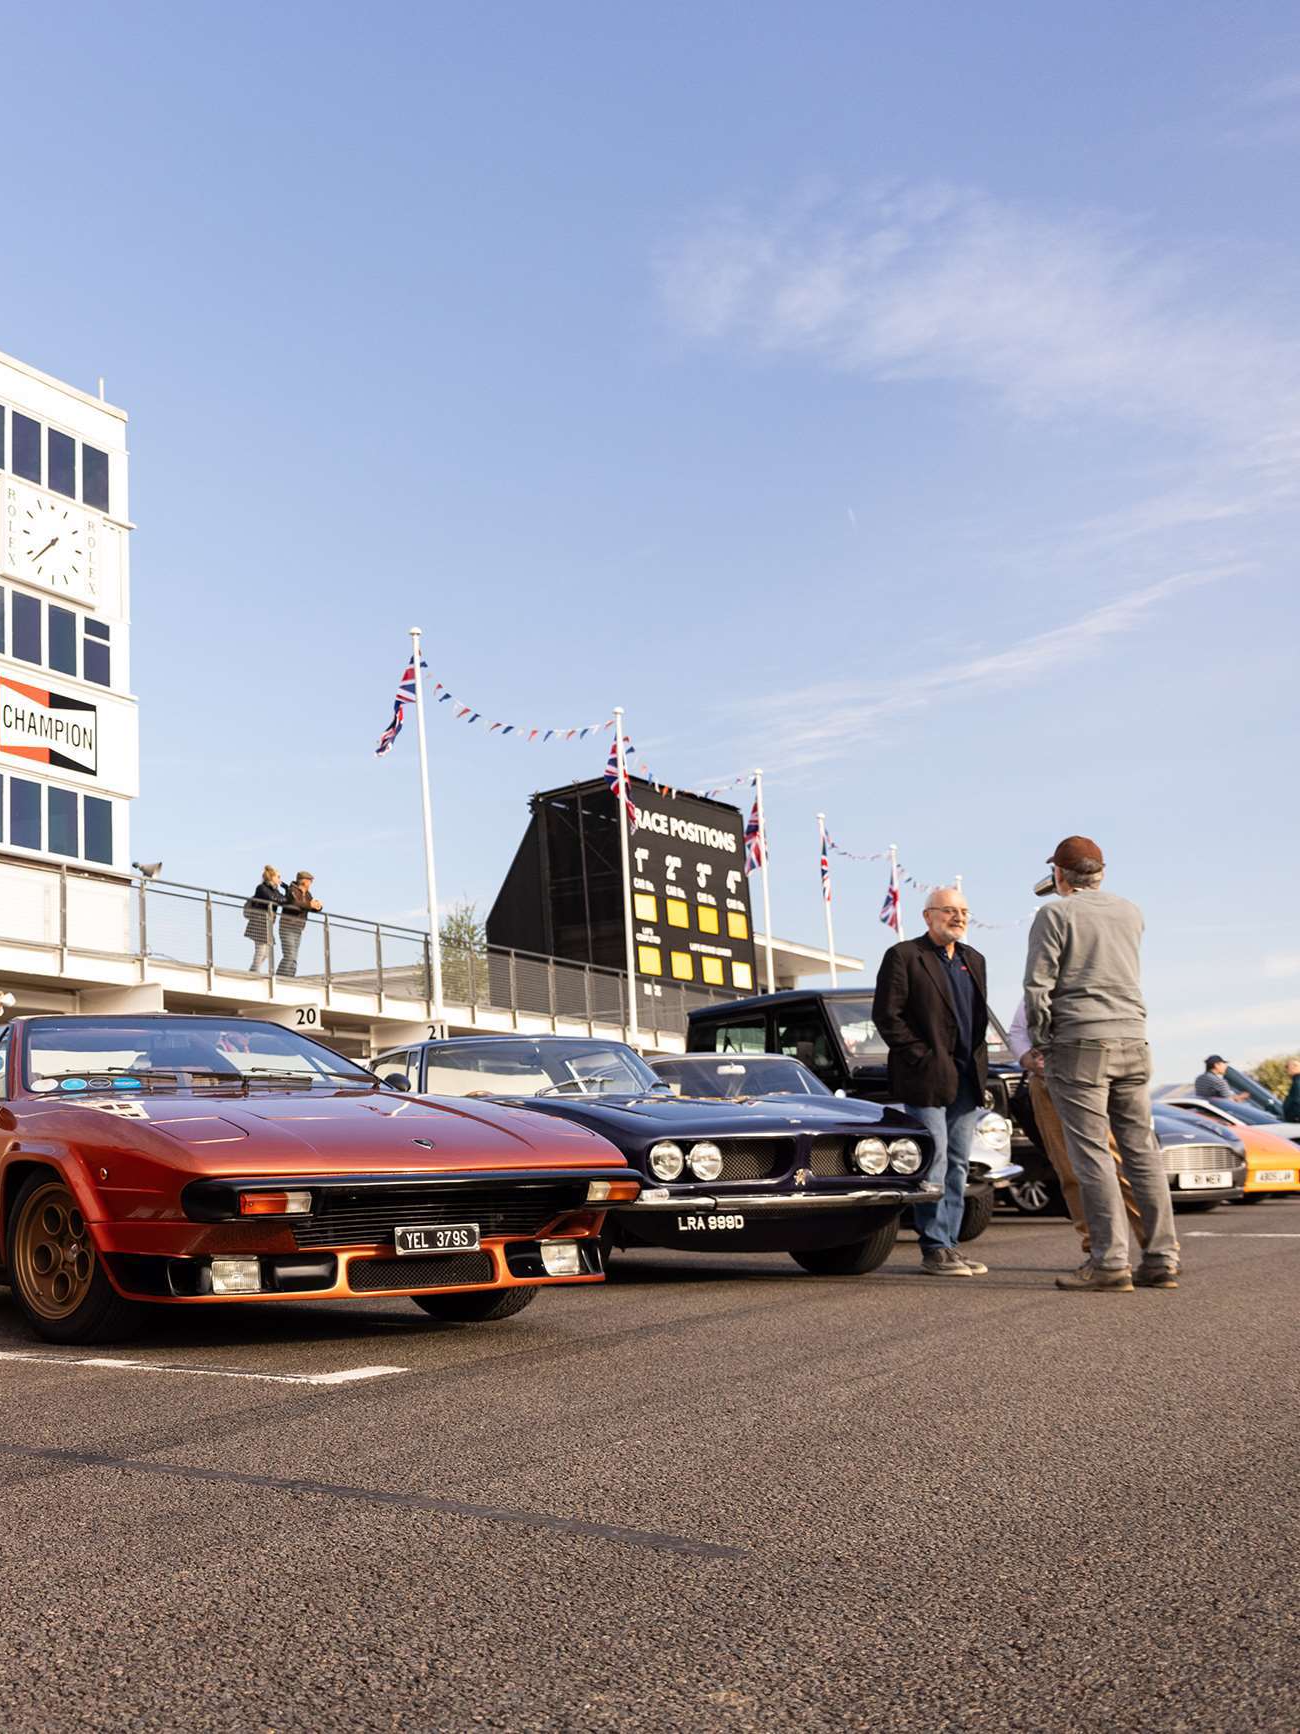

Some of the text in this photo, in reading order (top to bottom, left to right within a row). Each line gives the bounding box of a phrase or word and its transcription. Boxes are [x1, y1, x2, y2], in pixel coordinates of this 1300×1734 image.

[3, 704, 93, 751] CHAMPION
[635, 807, 737, 854] RACE POSITIONS
[295, 1008, 316, 1025] 20
[427, 1025, 444, 1039] 21
[677, 1216, 706, 1231] LRA
[406, 1230, 469, 1249] YEL 379S
